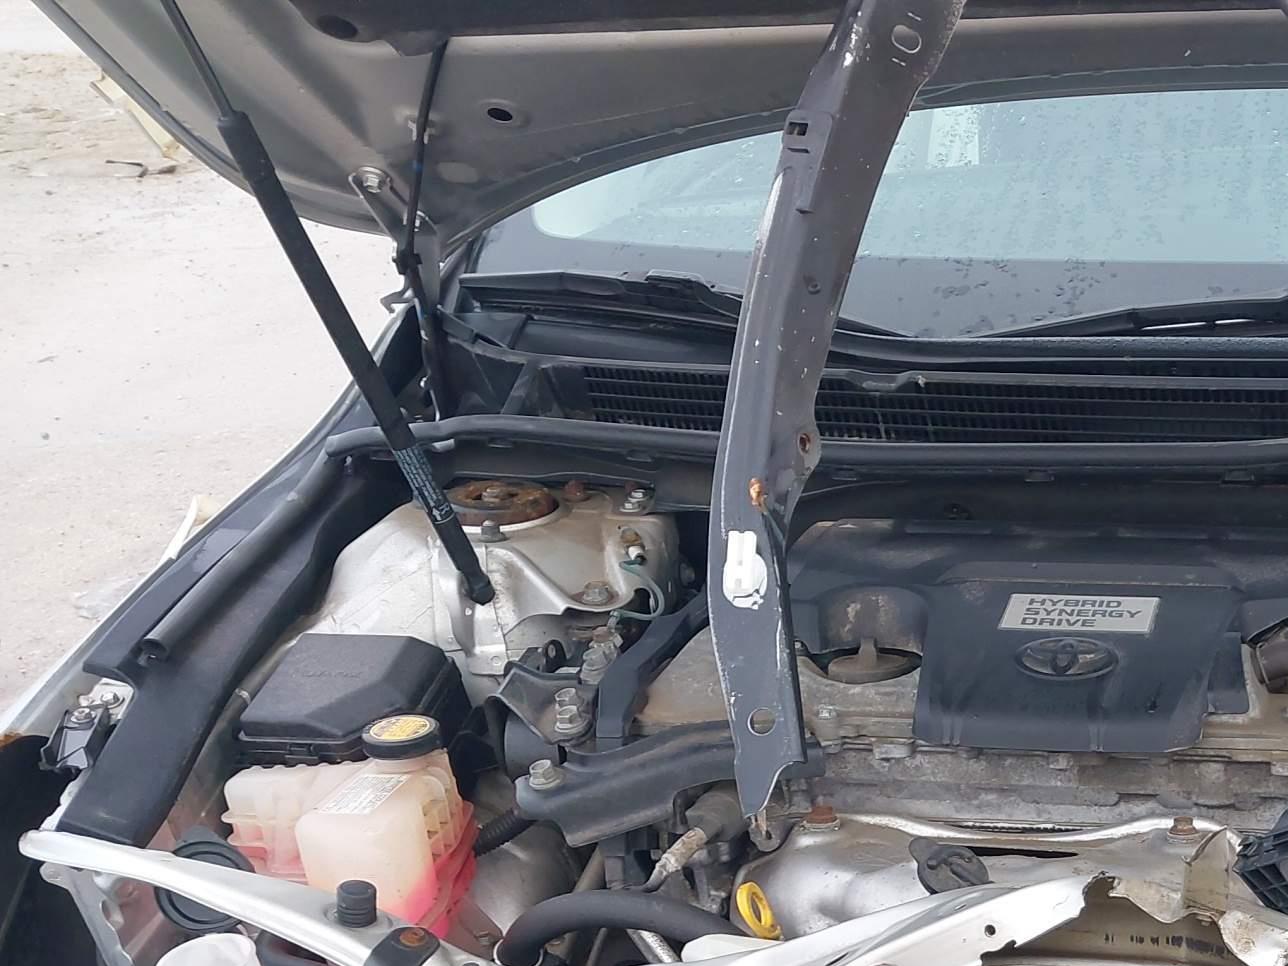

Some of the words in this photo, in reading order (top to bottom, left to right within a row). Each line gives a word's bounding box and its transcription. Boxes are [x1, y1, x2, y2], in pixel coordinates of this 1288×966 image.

[1028, 597, 1122, 609] HYBRID
[1024, 607, 1142, 619] SYNERGY
[1020, 616, 1097, 628] DRIVE
